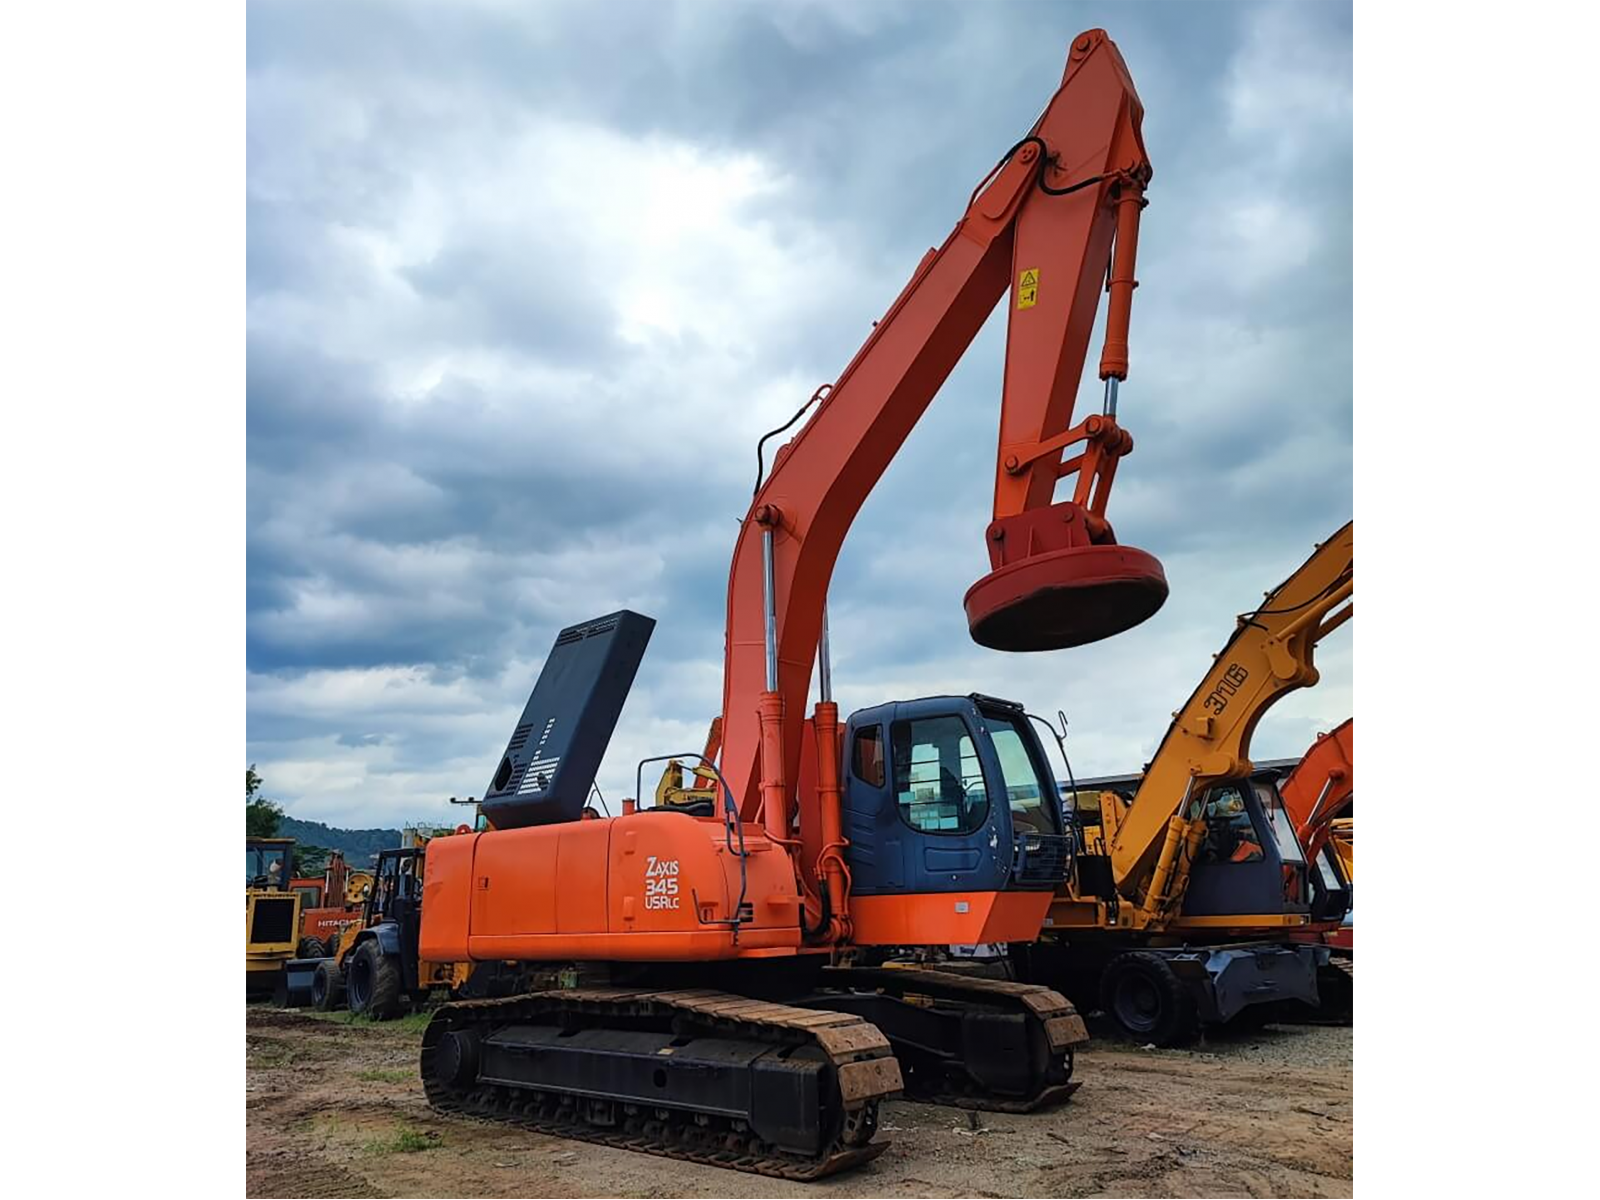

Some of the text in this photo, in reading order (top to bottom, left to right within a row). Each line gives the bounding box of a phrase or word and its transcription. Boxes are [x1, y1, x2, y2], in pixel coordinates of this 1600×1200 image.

[1204, 663, 1248, 715] 316
[645, 878, 678, 896] 345
[317, 919, 351, 928] HITAC
